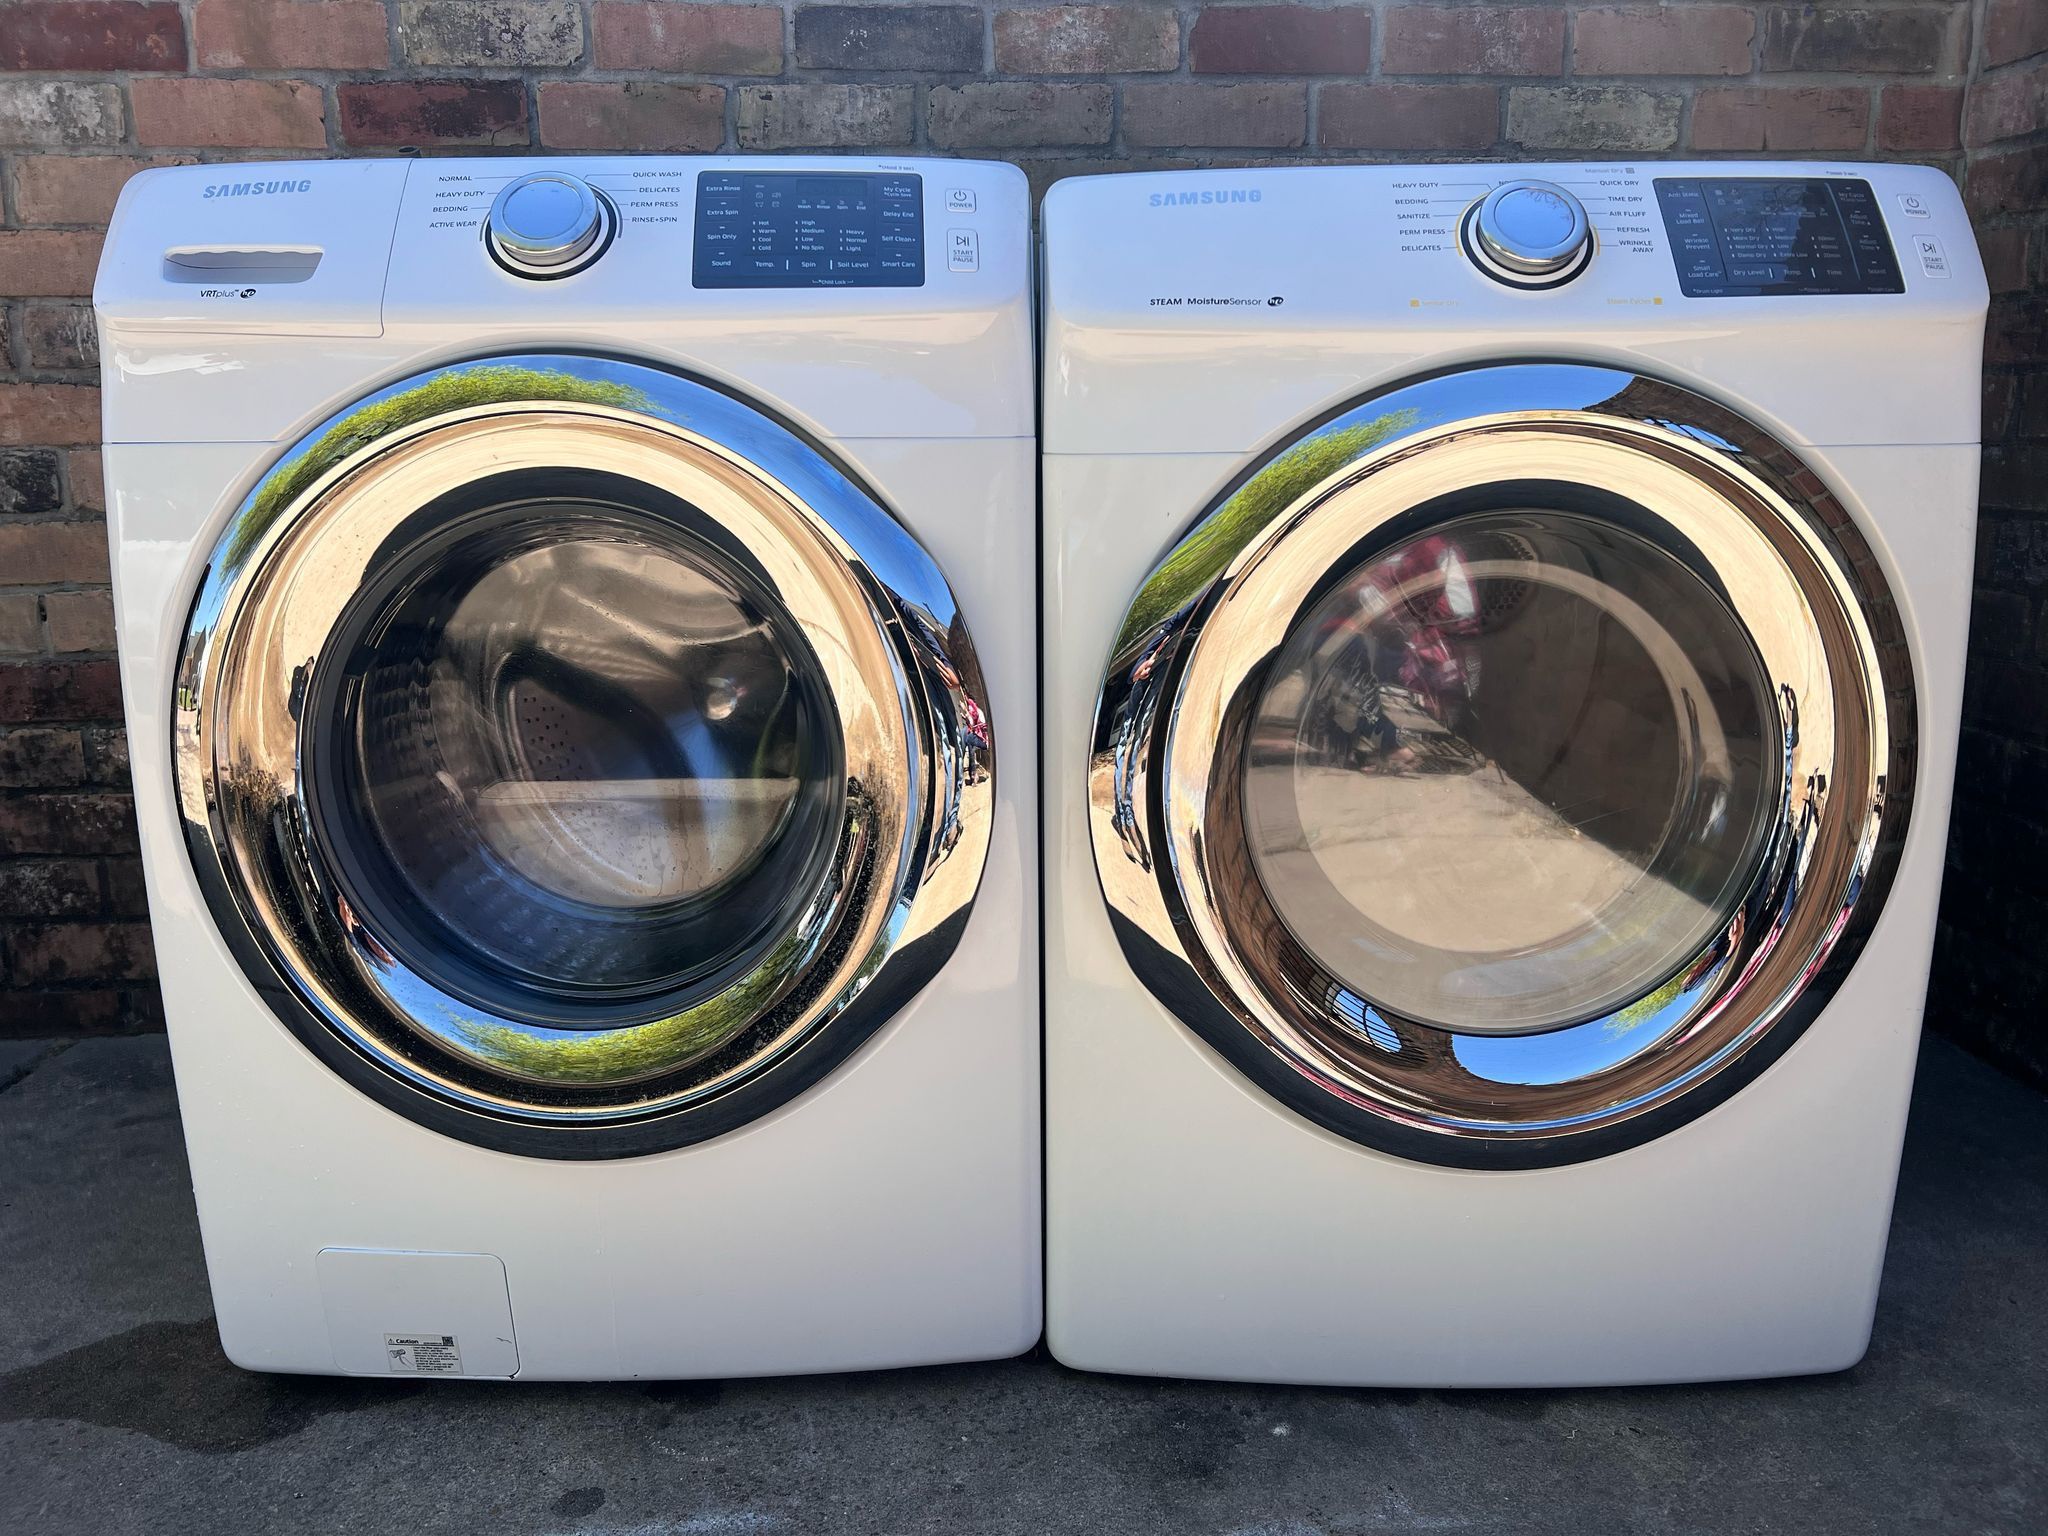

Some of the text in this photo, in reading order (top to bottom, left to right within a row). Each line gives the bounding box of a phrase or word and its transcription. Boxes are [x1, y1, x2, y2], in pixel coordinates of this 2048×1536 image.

[203, 180, 312, 198] SAMSUNG
[1150, 190, 1262, 207] SAMSUNG
[1150, 298, 1182, 306] STEAM
[1187, 297, 1261, 306] MoistureSensor
